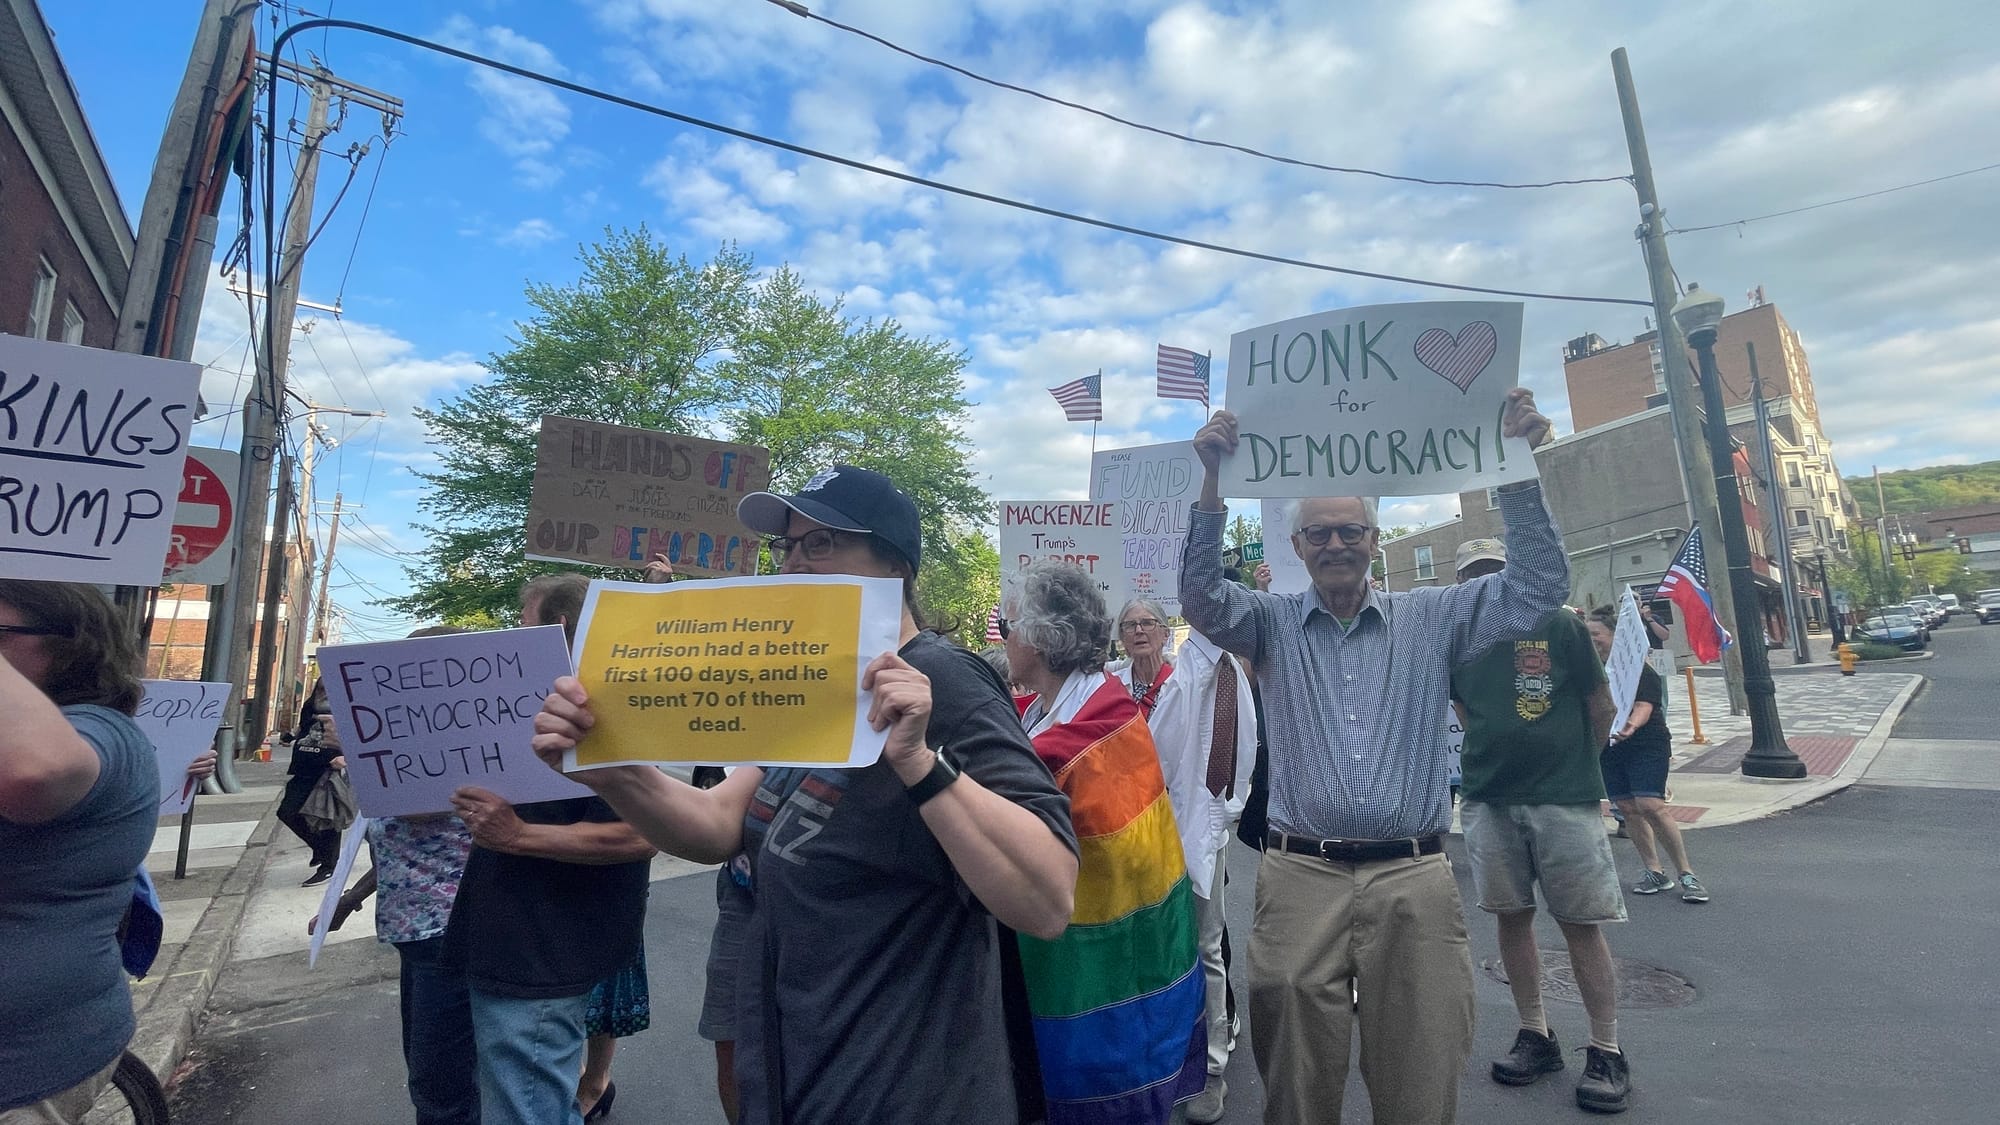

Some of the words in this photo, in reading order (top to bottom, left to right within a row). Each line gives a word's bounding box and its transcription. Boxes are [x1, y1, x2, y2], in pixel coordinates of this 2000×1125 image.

[1247, 320, 1398, 386] HONK
[0, 371, 187, 456] KINGS
[1330, 389, 1376, 413] for
[1239, 401, 1506, 482] DEMOCRACY!
[570, 426, 693, 482] HANDS
[704, 450, 757, 492] OFF
[572, 481, 610, 499] DATA
[1097, 457, 1192, 500] FUND
[0, 476, 163, 547] RUMP
[1006, 503, 1114, 526] MACKENZIE
[1120, 500, 1187, 534] DICAL
[536, 518, 600, 556] OUR
[611, 524, 760, 575] DEMOCRACY
[1031, 533, 1076, 552] Trump's
[656, 619, 728, 635] William
[732, 618, 794, 635] Henry
[611, 643, 700, 659] Harrison
[704, 641, 743, 657] had
[748, 645, 760, 657] a
[765, 641, 829, 656] better
[339, 651, 524, 702] FREEDOM
[604, 667, 648, 682] first
[654, 666, 693, 682] 100
[699, 666, 754, 685] days,
[759, 665, 798, 681] and
[804, 665, 828, 681] he
[628, 692, 688, 710] spent
[693, 692, 720, 707] 70
[725, 691, 752, 707] of
[752, 691, 806, 706] them
[689, 716, 747, 732] dead.
[358, 742, 505, 788] TRUTH
